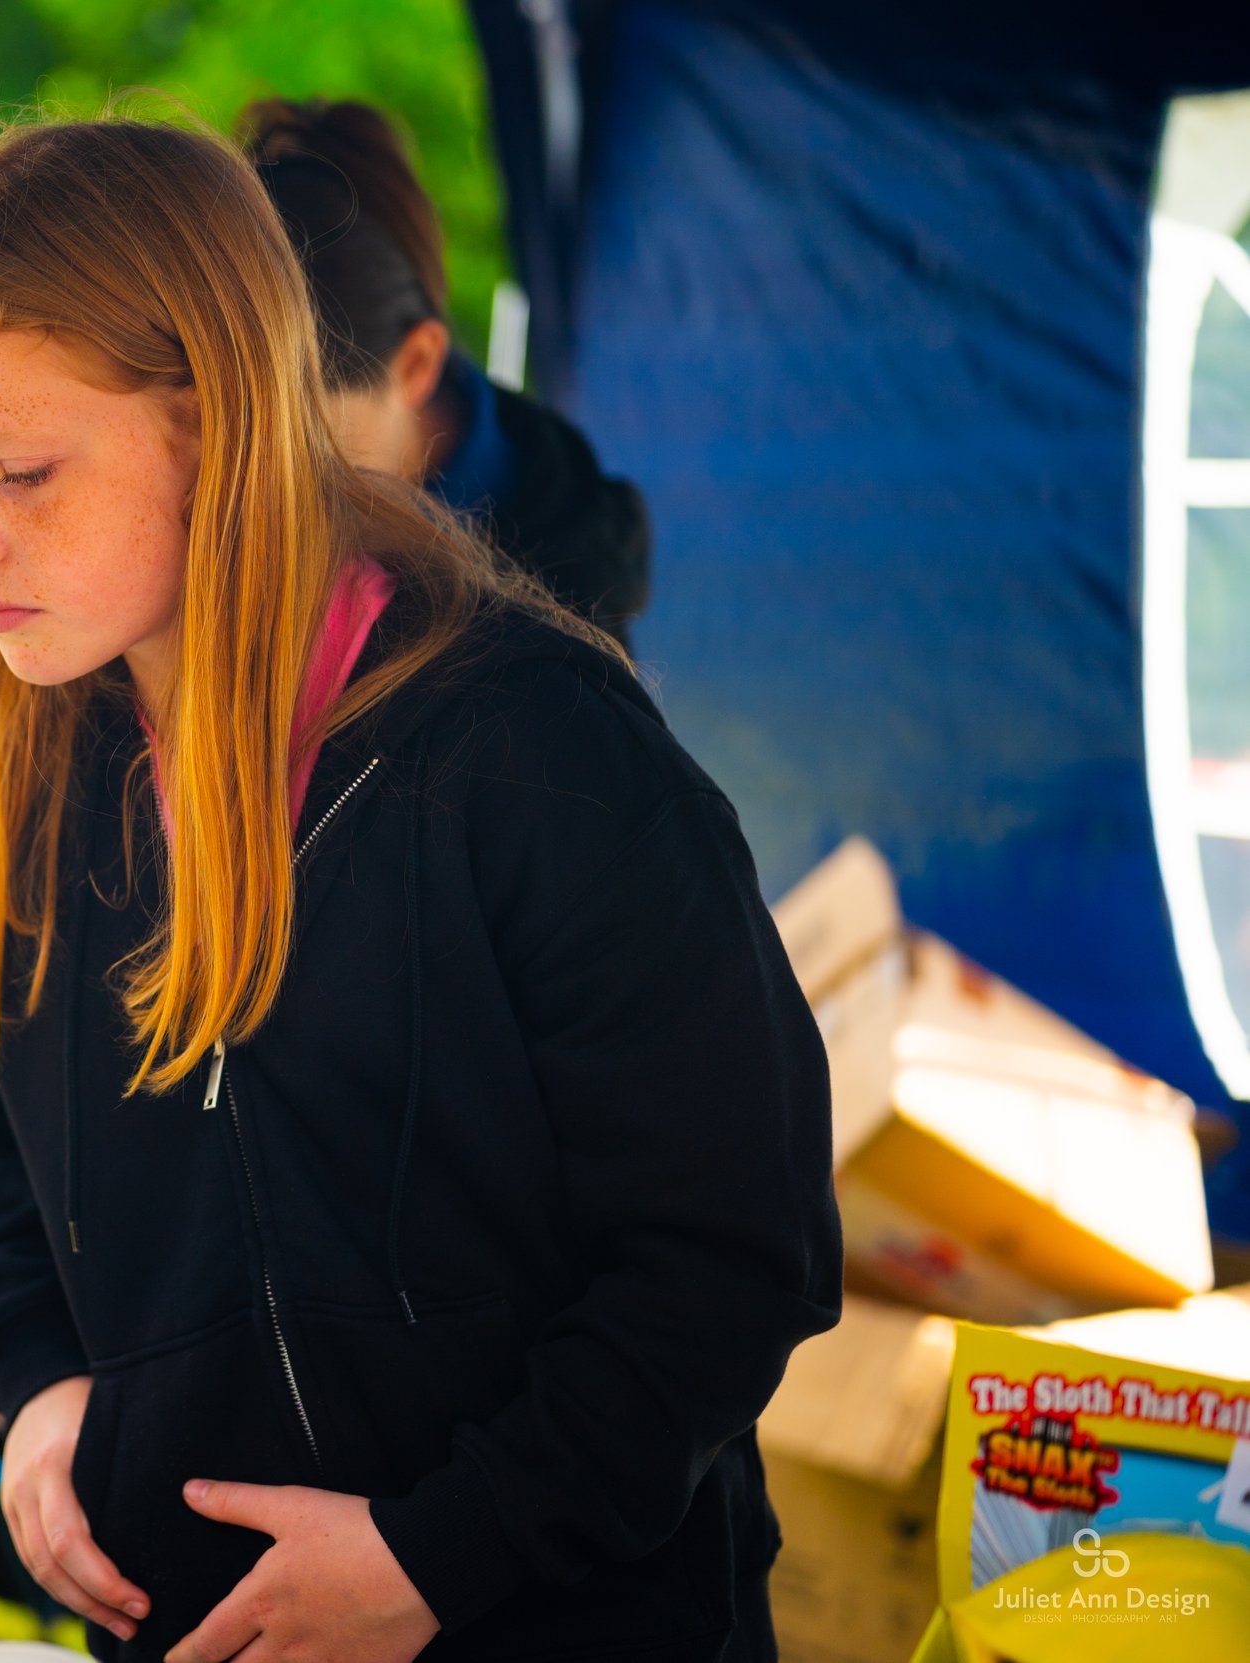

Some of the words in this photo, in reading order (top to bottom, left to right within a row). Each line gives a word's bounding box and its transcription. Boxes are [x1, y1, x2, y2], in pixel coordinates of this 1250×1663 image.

[971, 1376, 1027, 1412] The
[1034, 1376, 1112, 1415] Sloth
[1119, 1380, 1189, 1423] That
[988, 1433, 1095, 1486] SNAX
